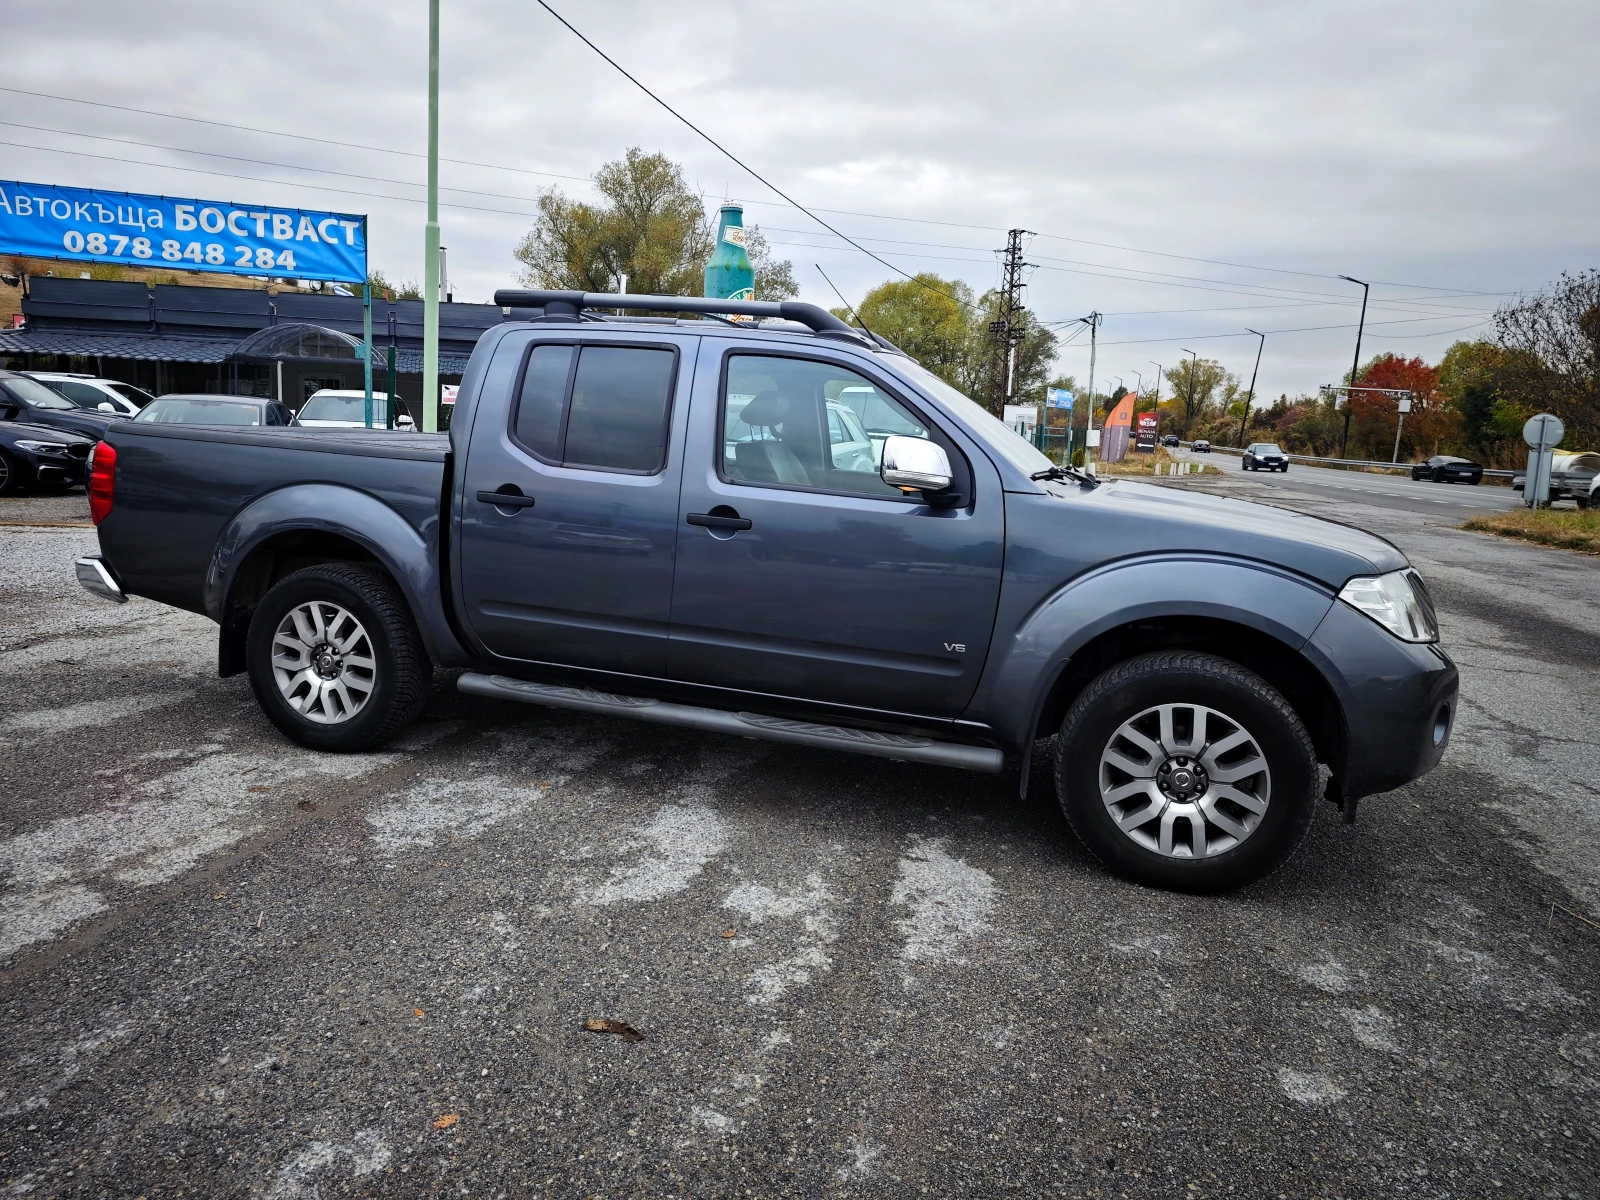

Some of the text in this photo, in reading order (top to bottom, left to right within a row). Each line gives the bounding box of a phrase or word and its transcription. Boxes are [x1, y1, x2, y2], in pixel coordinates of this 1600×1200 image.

[175, 204, 359, 246] БОСТВАСТ
[63, 230, 297, 271] 0878 848 284
[943, 642, 966, 653] V6
